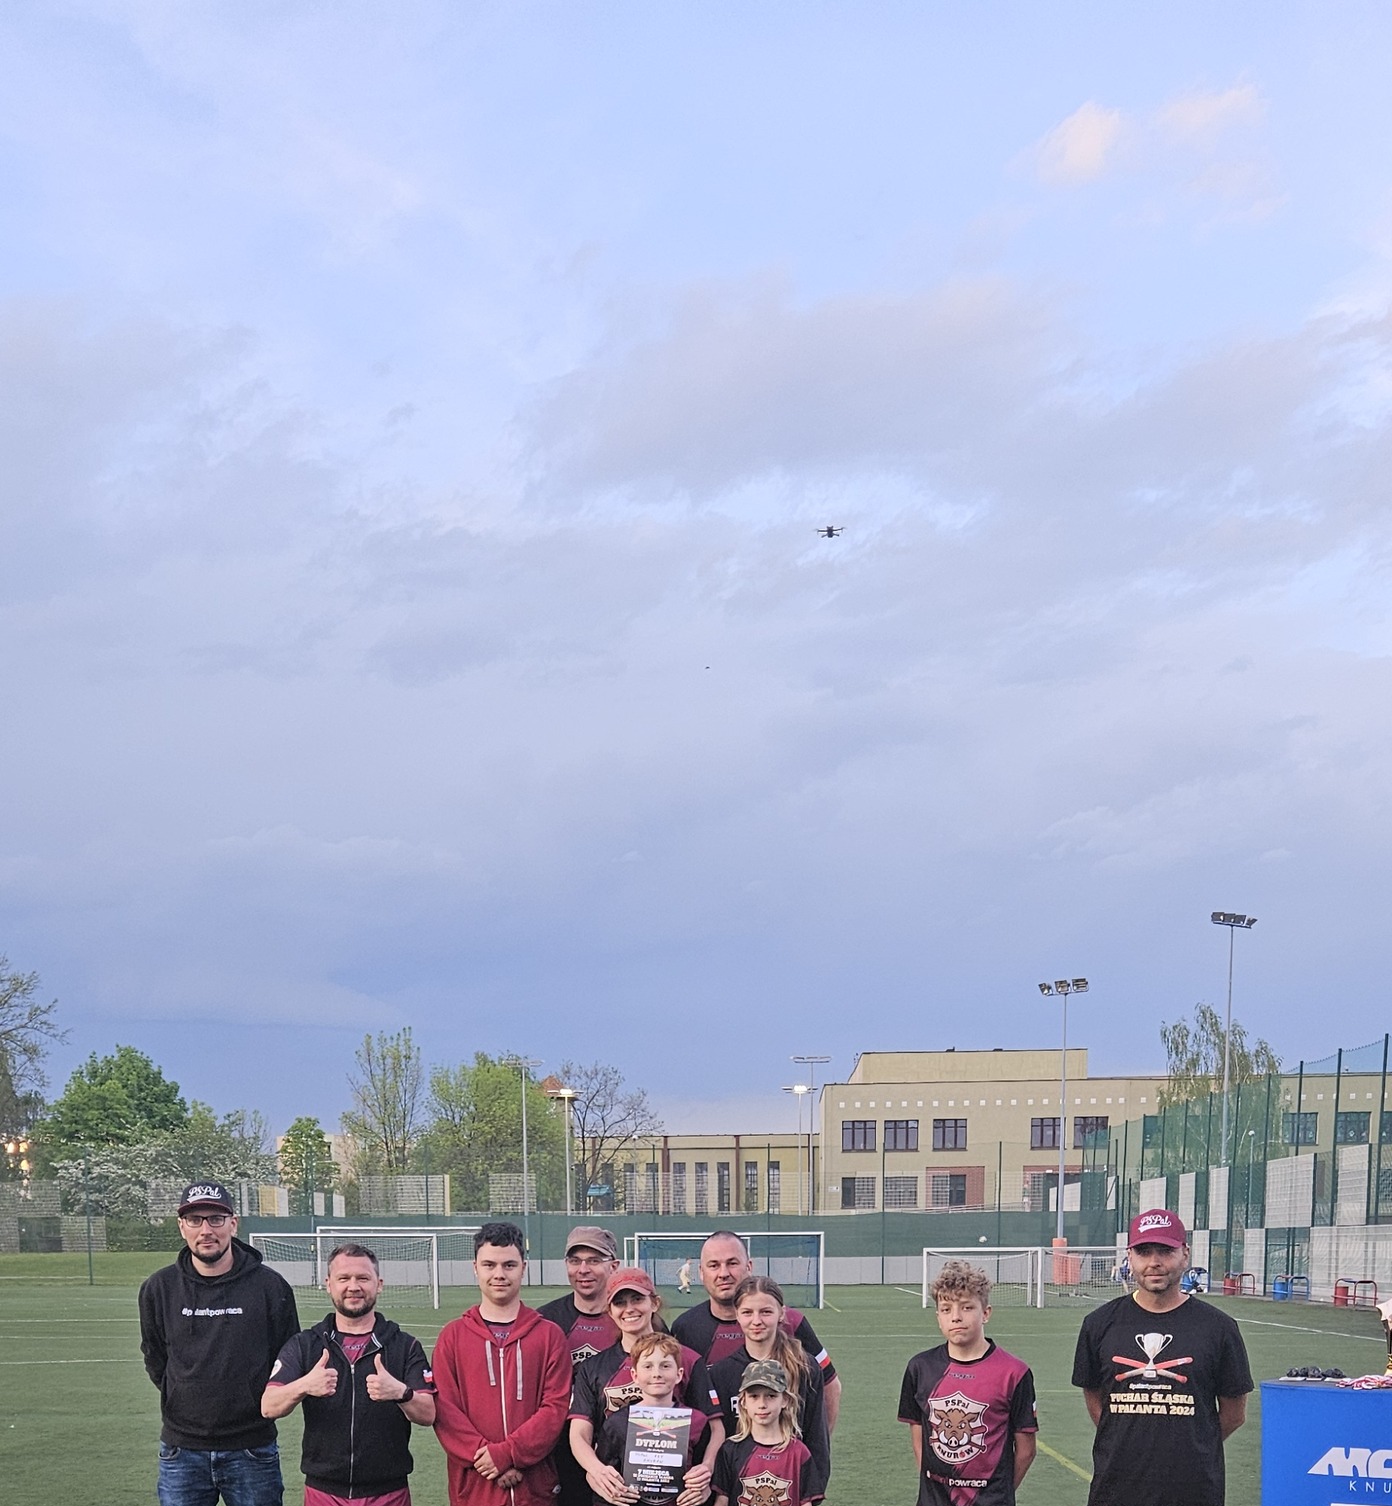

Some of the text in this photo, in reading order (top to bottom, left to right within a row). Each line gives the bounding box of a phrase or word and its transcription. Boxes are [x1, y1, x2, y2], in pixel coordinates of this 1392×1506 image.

[188, 1185, 220, 1197] PSPal
[1140, 1214, 1169, 1227] PSPal
[944, 1399, 970, 1409] PSPal
[1109, 1391, 1195, 1405] PUCHAR ŚLĄSKA
[1109, 1404, 1196, 1416] W PALANTA 2024
[635, 1438, 677, 1449] DYPLOM
[755, 1477, 778, 1485] PSPal
[1349, 1480, 1391, 1494] KNU
